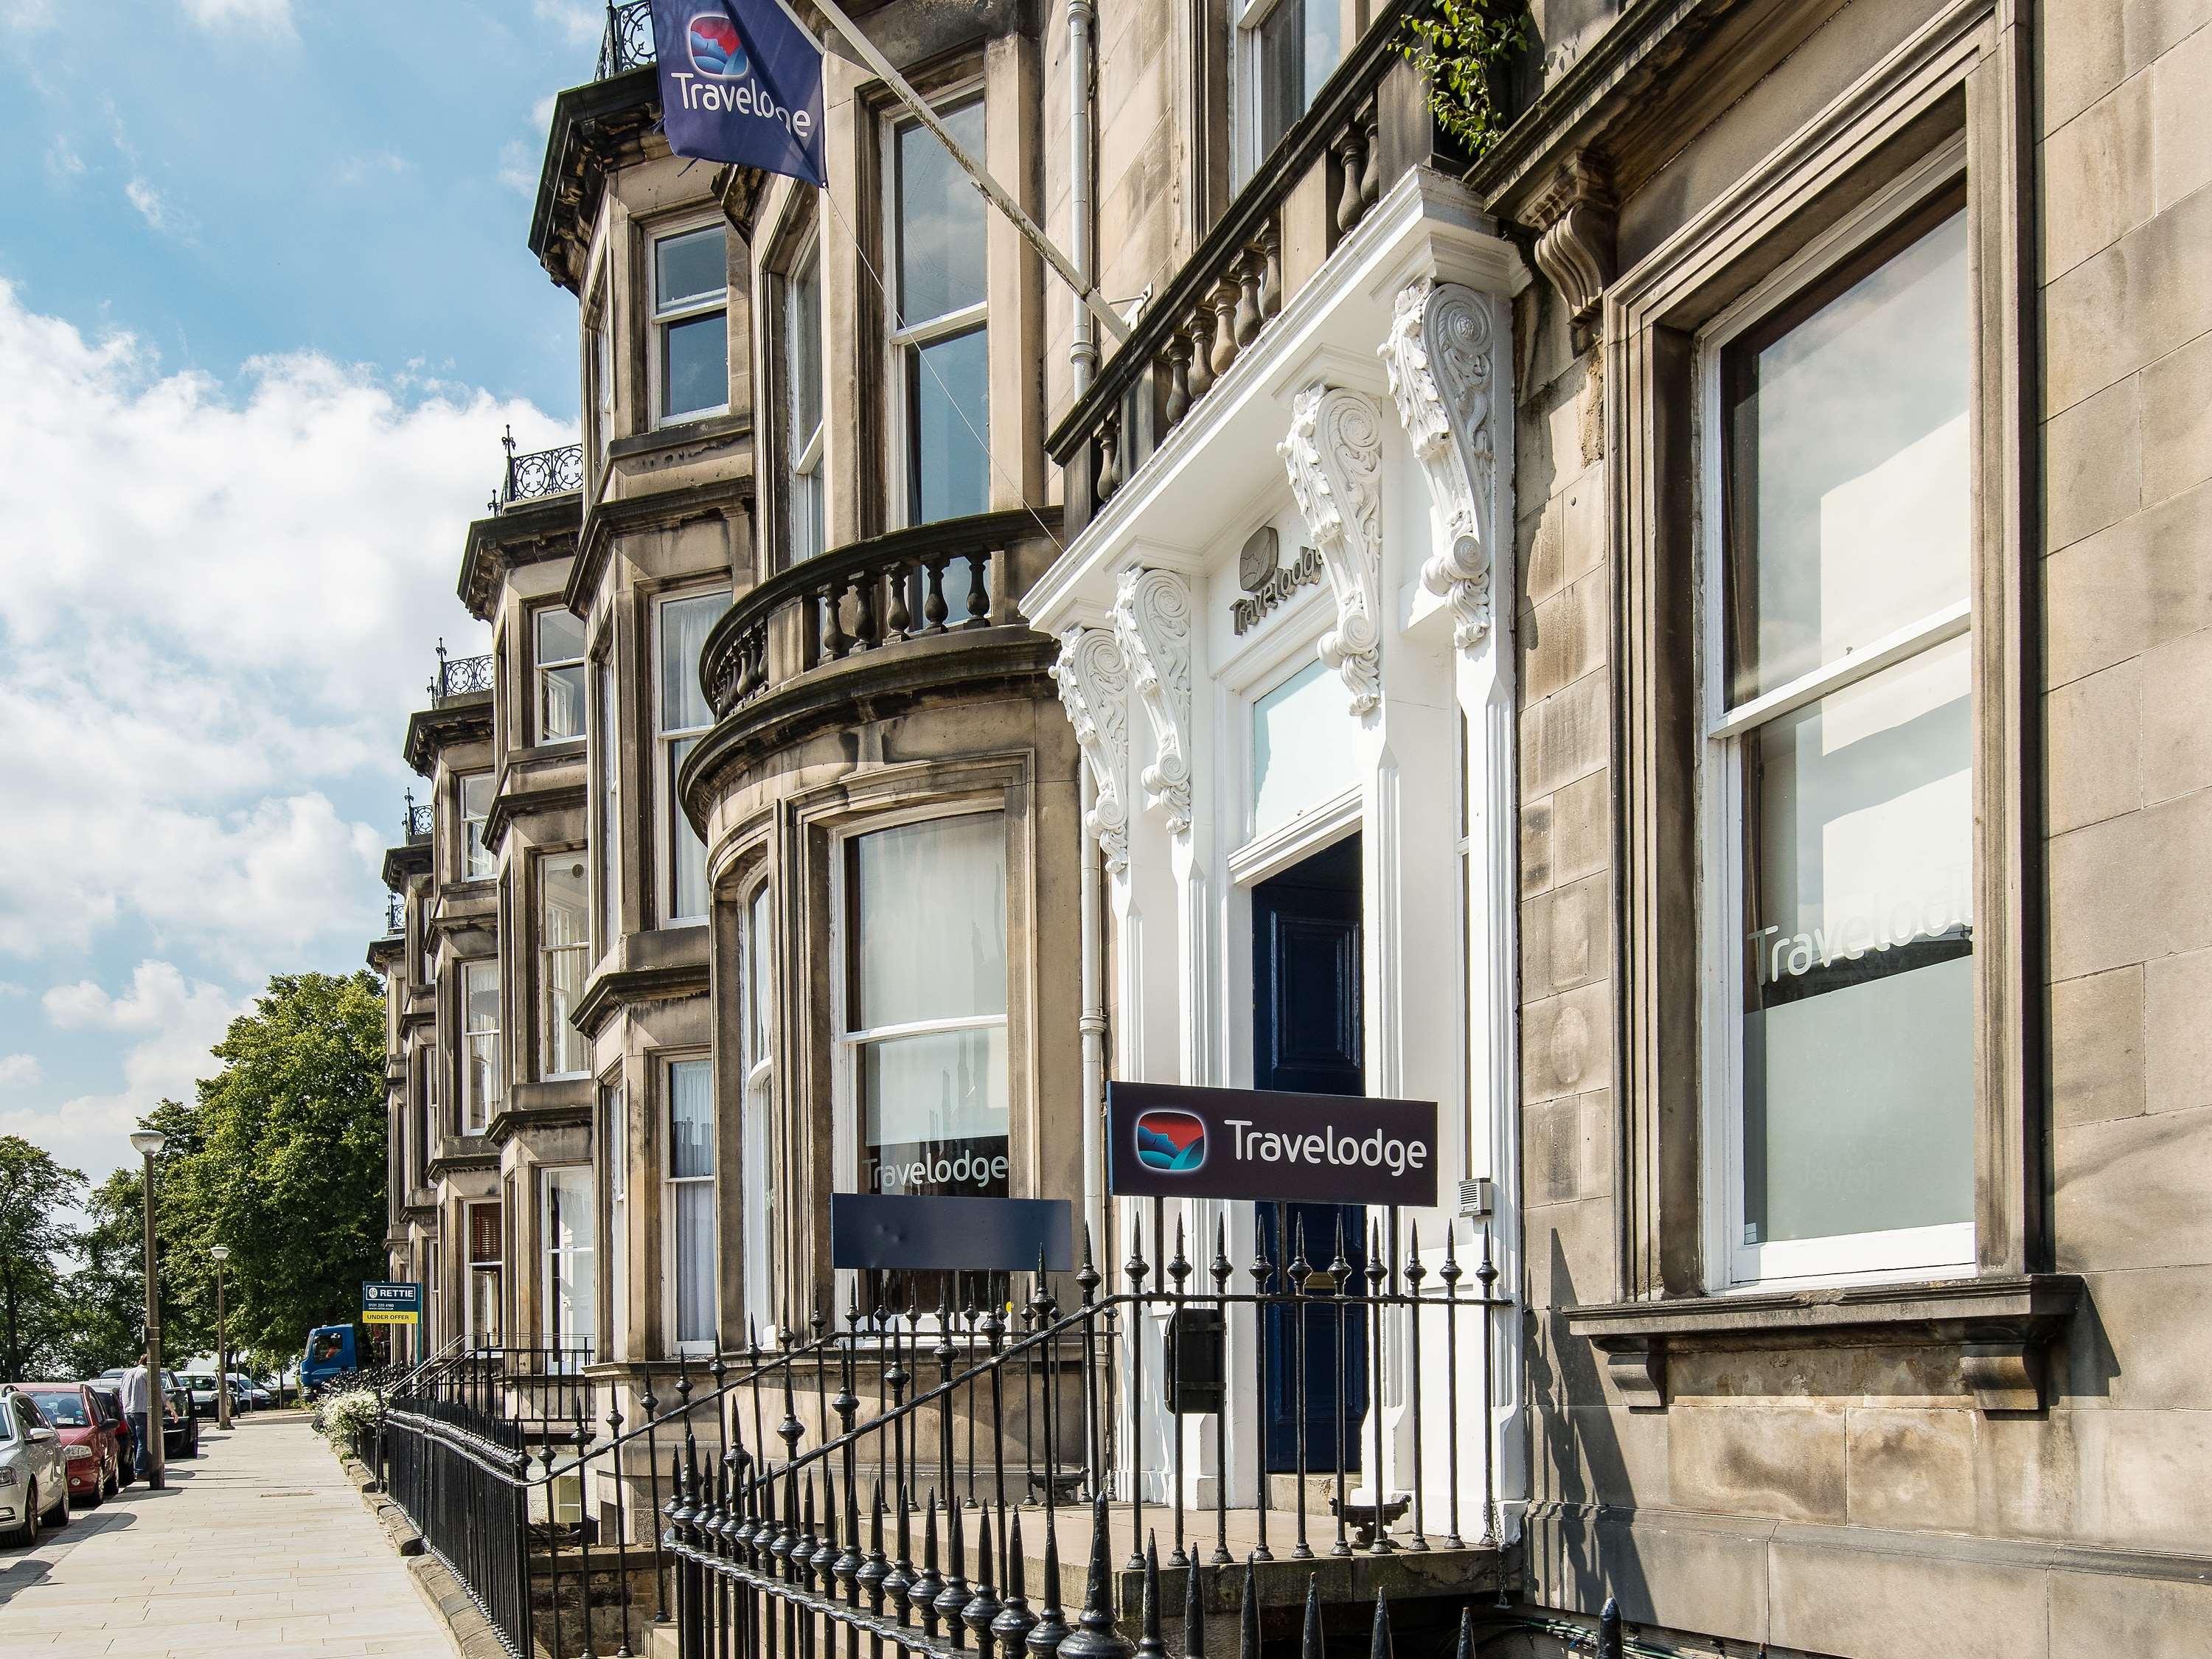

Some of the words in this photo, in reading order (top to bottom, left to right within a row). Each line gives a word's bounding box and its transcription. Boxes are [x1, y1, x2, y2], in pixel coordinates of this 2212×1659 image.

[1224, 1119, 1427, 1177] Travelodge
[862, 1149, 1009, 1188] Travelodge
[380, 1289, 414, 1298] RETTIE
